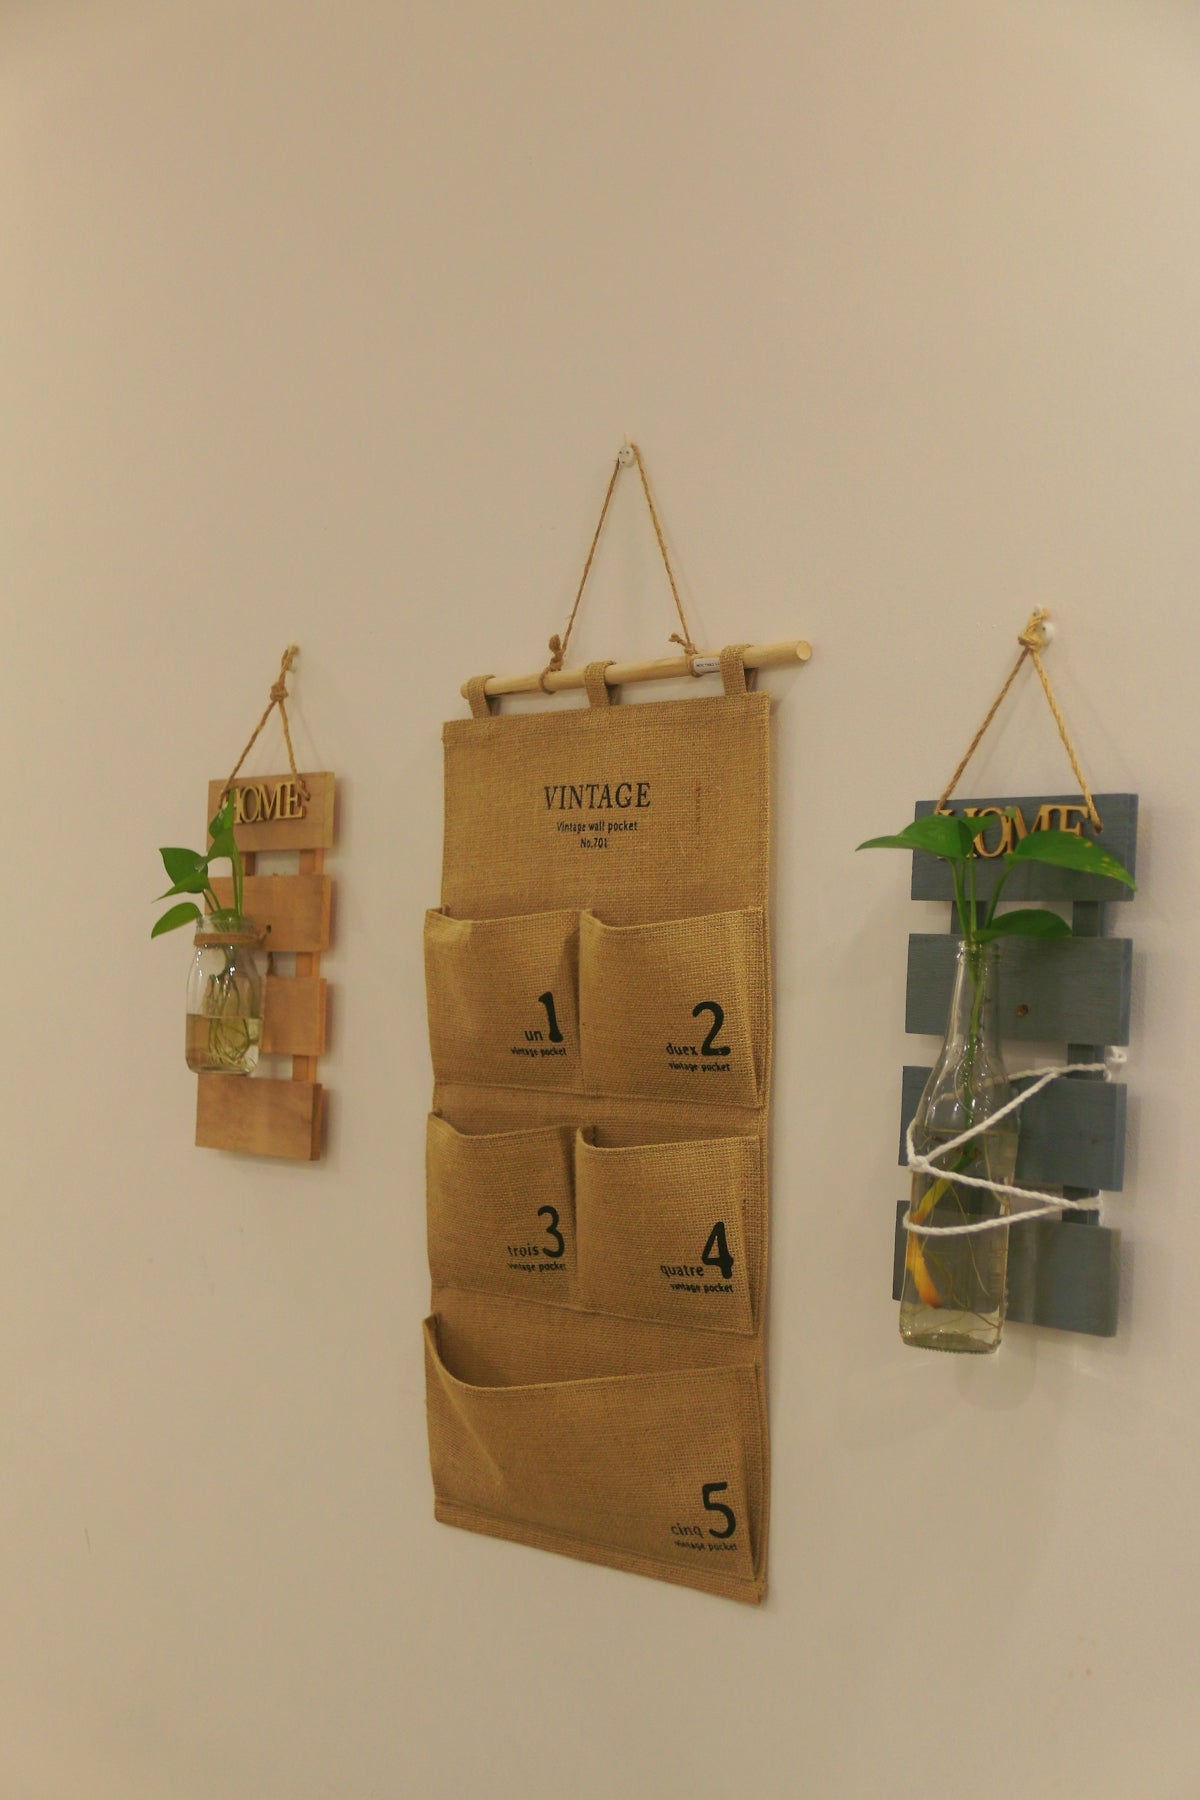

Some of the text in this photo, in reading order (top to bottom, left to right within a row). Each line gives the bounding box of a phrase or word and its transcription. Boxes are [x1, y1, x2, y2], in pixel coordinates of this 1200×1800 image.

[544, 782, 651, 810] VINTAGE
[557, 821, 638, 834] Vintage wall pocket
[580, 837, 607, 849] No.701
[934, 803, 1090, 859] OME
[524, 991, 563, 1043] un 1
[666, 1001, 731, 1056] duex 2
[507, 1205, 565, 1258] trois 3
[660, 1221, 734, 1279] quatre 4
[671, 1481, 736, 1539] cinq 5
